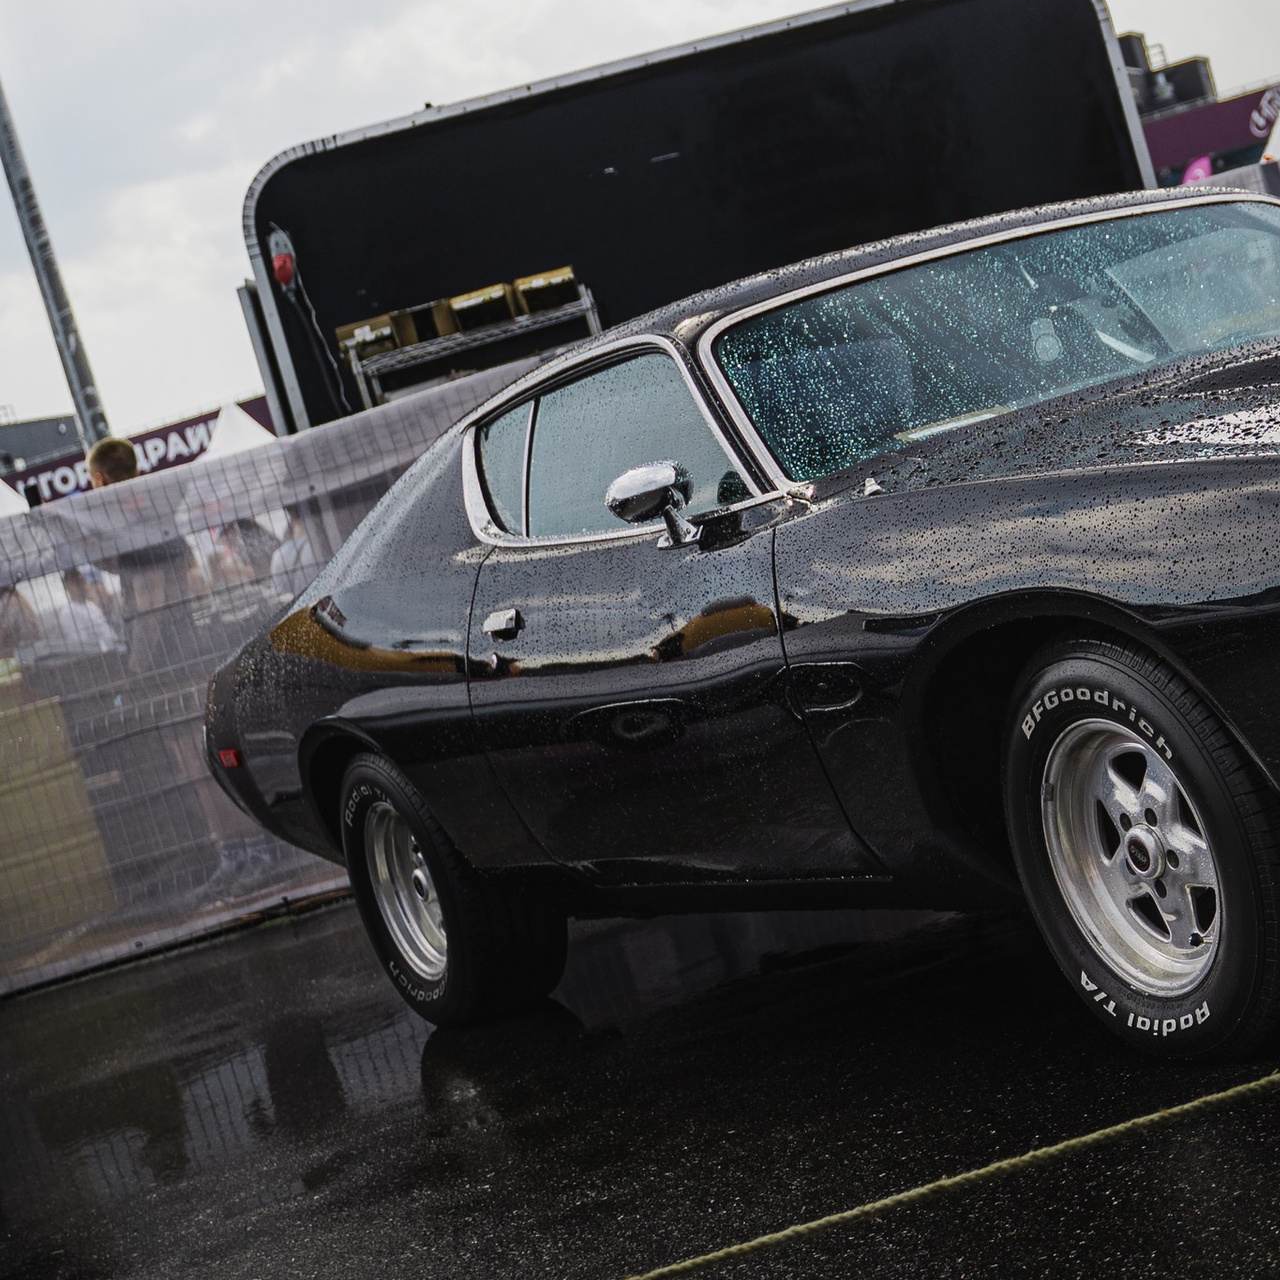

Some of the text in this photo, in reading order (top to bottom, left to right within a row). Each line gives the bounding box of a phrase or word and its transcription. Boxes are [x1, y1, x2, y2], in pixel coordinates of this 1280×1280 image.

[1021, 686, 1174, 760] BFGoodrich
[1080, 970, 1117, 1017] T/A
[1127, 1000, 1211, 1038] Radial
